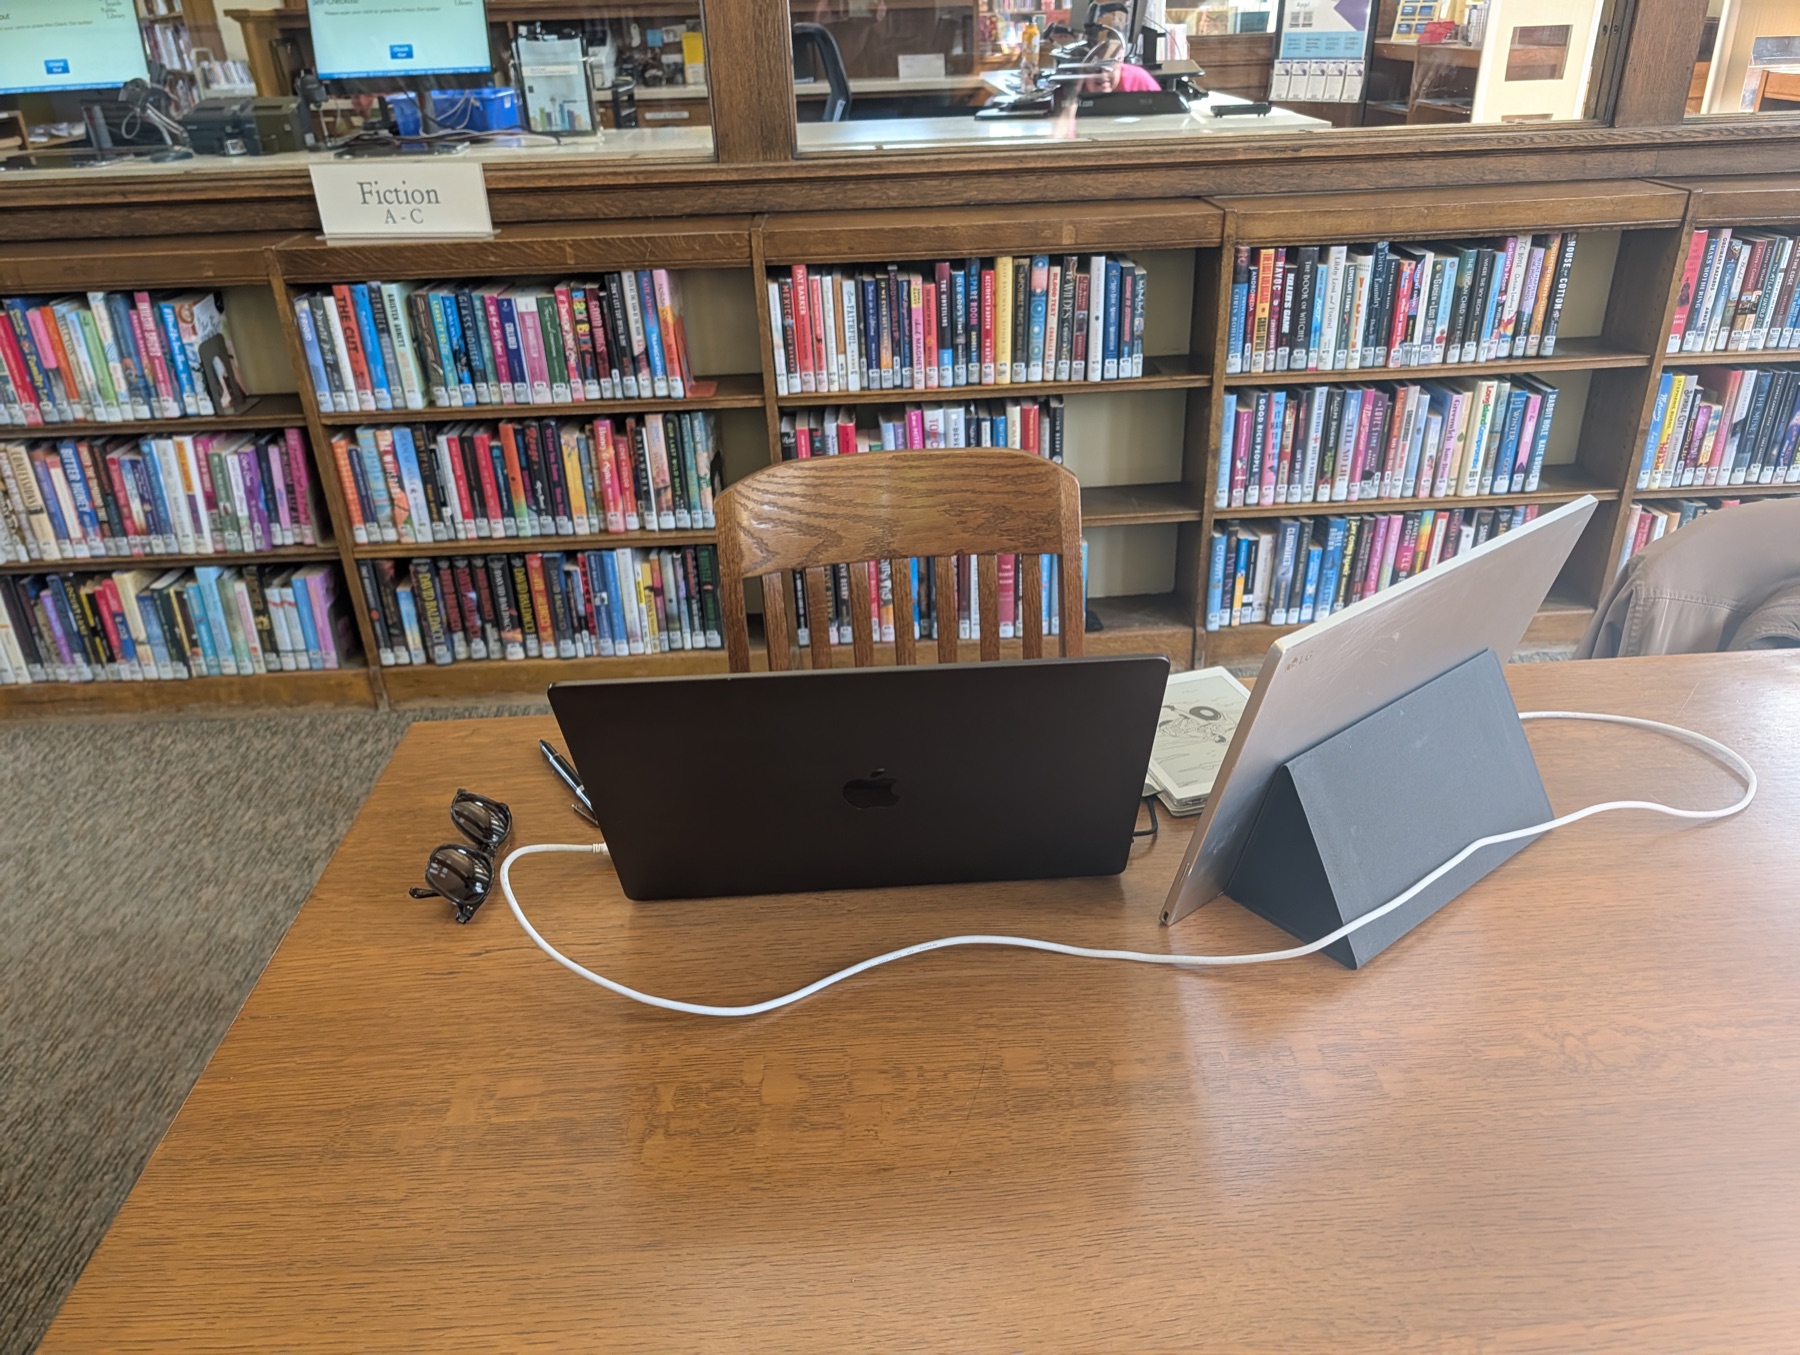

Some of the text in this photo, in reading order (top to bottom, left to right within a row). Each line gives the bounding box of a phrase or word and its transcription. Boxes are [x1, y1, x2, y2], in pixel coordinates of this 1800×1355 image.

[357, 180, 440, 205] Fiction
[385, 209, 397, 224] A
[410, 209, 424, 224] C
[1332, 257, 1341, 276] Libby
[1547, 243, 1556, 273] COLLECTED
[1710, 238, 1727, 291] ORDINARY HAZARDS
[1747, 246, 1763, 289] Letters Comfort
[1757, 246, 1773, 289] Letters Wisdom
[610, 283, 618, 299] DON'T
[1249, 271, 1257, 312] ANDROMEDA
[1273, 261, 1284, 291] HAVOC
[1302, 274, 1310, 299] BOOK
[1330, 278, 1339, 294] Lost
[1346, 267, 1354, 294] LOVELIGHT
[1372, 252, 1385, 308] Dirty Laundry
[1430, 279, 1442, 300] GARDEN
[1462, 271, 1472, 295] TUSCAN
[1494, 242, 1515, 328] Gabriel's Moon William
[1508, 252, 1524, 309] BOYLE Outside Looking
[1530, 273, 1539, 300] HAPPENS
[1554, 241, 1576, 310] HOUSE COTTON
[1695, 245, 1715, 309] MASS MOTHERING
[1787, 271, 1796, 286] EDGE
[782, 285, 792, 320] MEXICO
[796, 269, 806, 316] PAT BARKER
[1282, 273, 1294, 334] KILLER'S GAME
[1459, 296, 1467, 314] CHILD
[1758, 273, 1775, 318] ATLAS UNTOLD
[336, 295, 359, 353] THE CUT
[847, 305, 856, 346] FAITHFUL
[1297, 311, 1307, 342] WITCHES
[1327, 306, 1335, 329] Found
[1352, 278, 1364, 349] VICTIM
[1428, 305, 1438, 319] LOST
[457, 296, 479, 367] GLASS HOUSES
[505, 322, 517, 349] COLLIDED
[577, 323, 592, 351] BUCK
[1672, 380, 1682, 410] STEPHANIE
[1677, 390, 1693, 429] SPINDLE CITY
[1756, 394, 1765, 407] THE
[1252, 398, 1266, 473] GOOD RICH PEOPLE
[1370, 408, 1383, 448] LOVE'S TIME
[1446, 399, 1460, 441] Greenwich
[1472, 385, 1493, 470] Long Island Compromise
[1507, 410, 1520, 442] WINTER
[1537, 394, 1556, 455] RABBIT HOLE KATE
[1343, 423, 1354, 462] TELL NO
[1283, 528, 1295, 566] CLOUDMAKER
[1328, 528, 1337, 550] BROWN
[1335, 531, 1343, 547] DALE
[1403, 520, 1413, 546] BROWN
[1409, 518, 1418, 547] JANELLE
[1214, 545, 1223, 579] crown
[1226, 554, 1235, 575] EVIL
[1401, 552, 1410, 569] I'LL
[513, 567, 535, 632] DAVID BALDACCI
[551, 570, 566, 630] DAVID BALDACCI
[840, 578, 848, 599] BERRY
[1225, 579, 1232, 590] IN
[418, 573, 444, 642] DAVID BALDACCI
